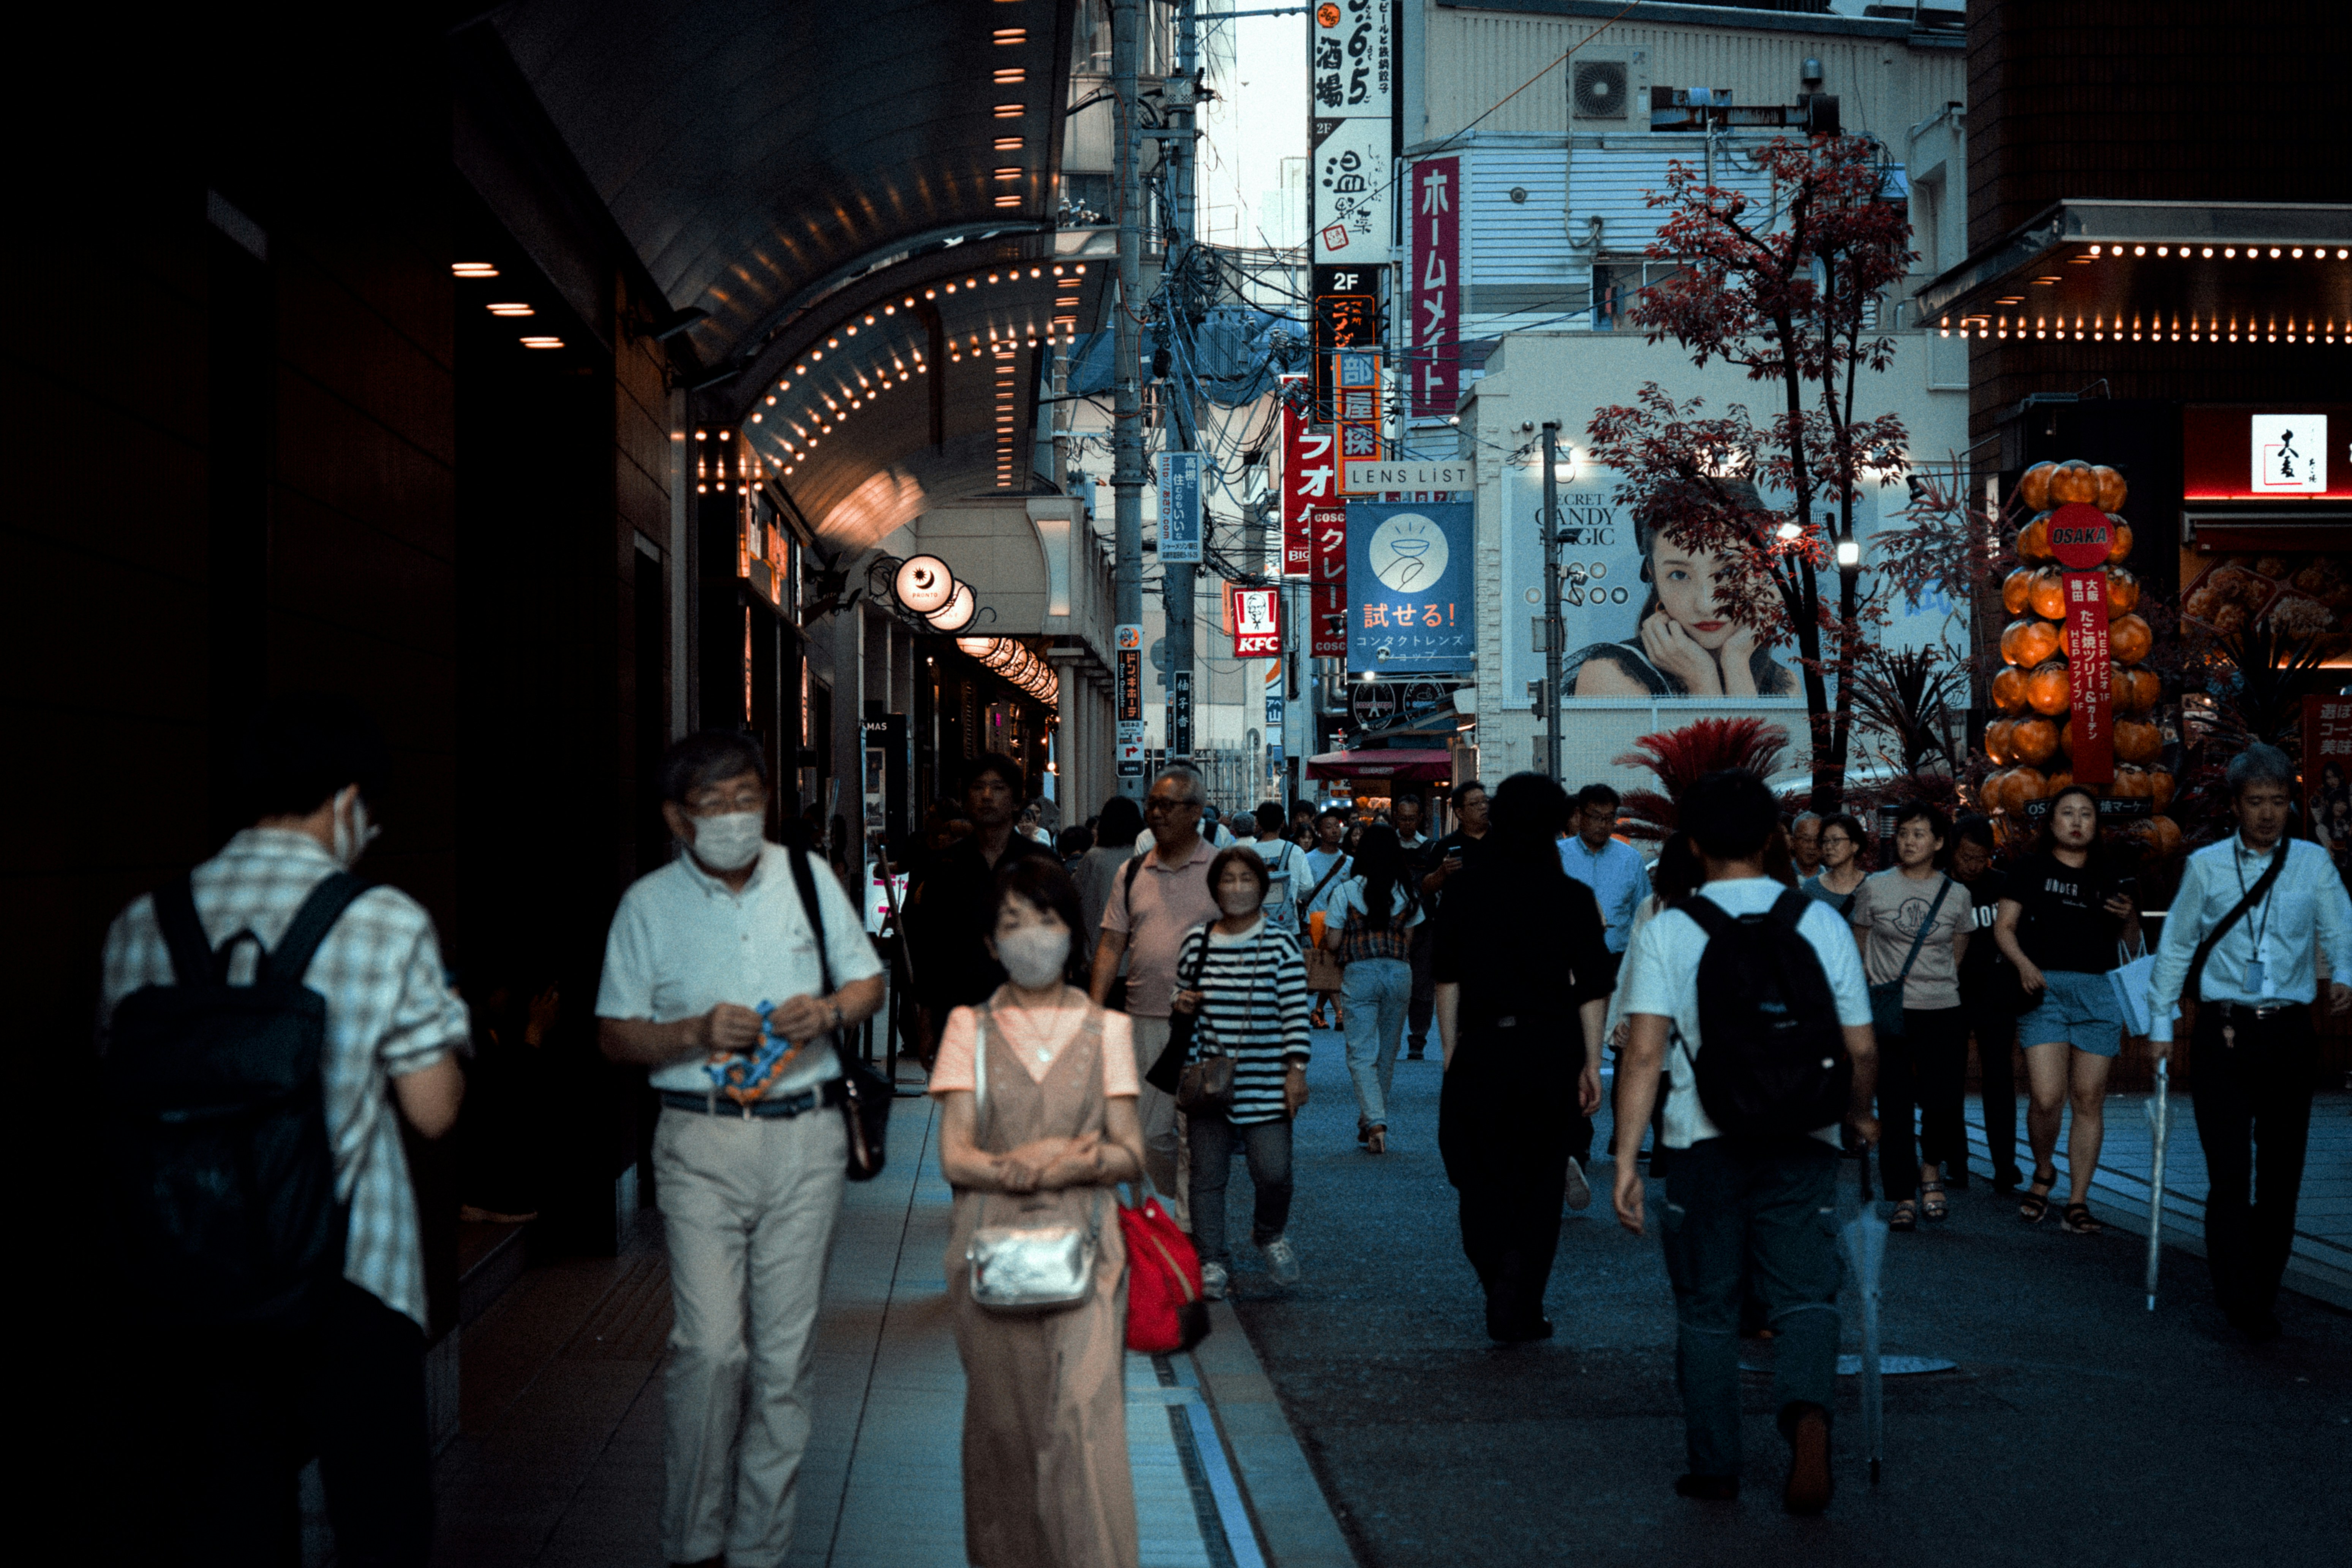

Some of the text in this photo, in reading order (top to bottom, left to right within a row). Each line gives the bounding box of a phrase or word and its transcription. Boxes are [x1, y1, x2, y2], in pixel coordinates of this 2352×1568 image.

[1317, 36, 1343, 107] 酒場
[1317, 123, 1332, 133] 2F
[1334, 273, 1358, 290] 2F
[1423, 169, 1448, 405] ホームメイト
[1353, 469, 1406, 483] LENS
[1173, 474, 1184, 539] 住むのもいいな
[1557, 494, 1604, 505] ECRET
[1538, 528, 1614, 545] GIC
[2053, 527, 2107, 544] OSAKA
[2071, 579, 2084, 602] 梅田
[2086, 579, 2099, 601] 大阪
[1363, 603, 1454, 628] 試せる!
[1238, 637, 1279, 651] KFC
[1357, 635, 1463, 646] コンタクトレンズ
[2071, 630, 2080, 657] HEP
[2098, 630, 2111, 702] HEP ナビオ 1F
[2073, 702, 2084, 711] 1F
[2319, 723, 2352, 736] コー
